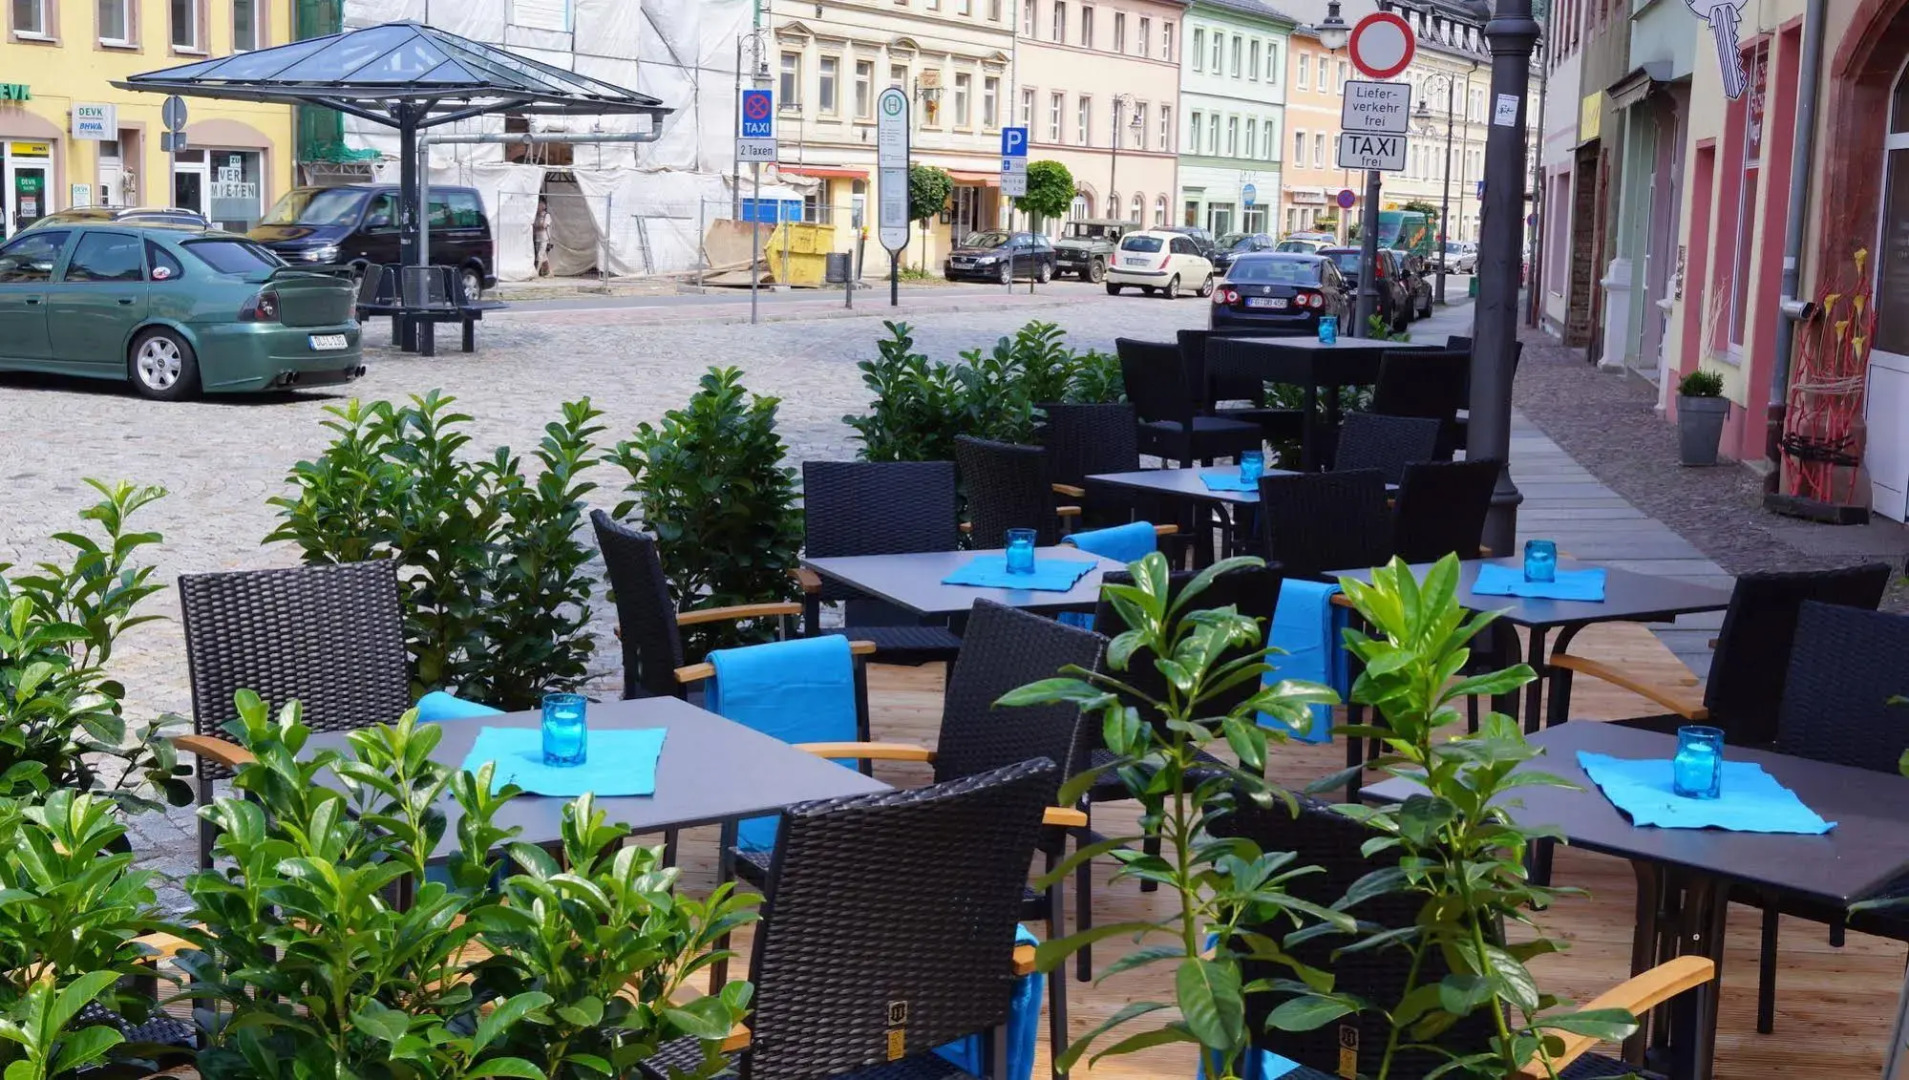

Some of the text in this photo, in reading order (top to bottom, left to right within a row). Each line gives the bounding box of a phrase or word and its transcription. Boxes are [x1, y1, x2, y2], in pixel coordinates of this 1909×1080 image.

[1356, 86, 1398, 98] Liefer-
[888, 98, 897, 111] H
[1353, 102, 1400, 113] verkehr
[79, 107, 103, 116] DEVK
[1365, 115, 1385, 126] frei
[744, 122, 769, 134] TAXI
[1007, 130, 1022, 154] P
[1348, 136, 1397, 157] TAXI
[740, 144, 773, 156] 2 Taxen
[1361, 156, 1382, 167] frei
[220, 169, 241, 181] VER
[211, 184, 255, 197] MIETEN
